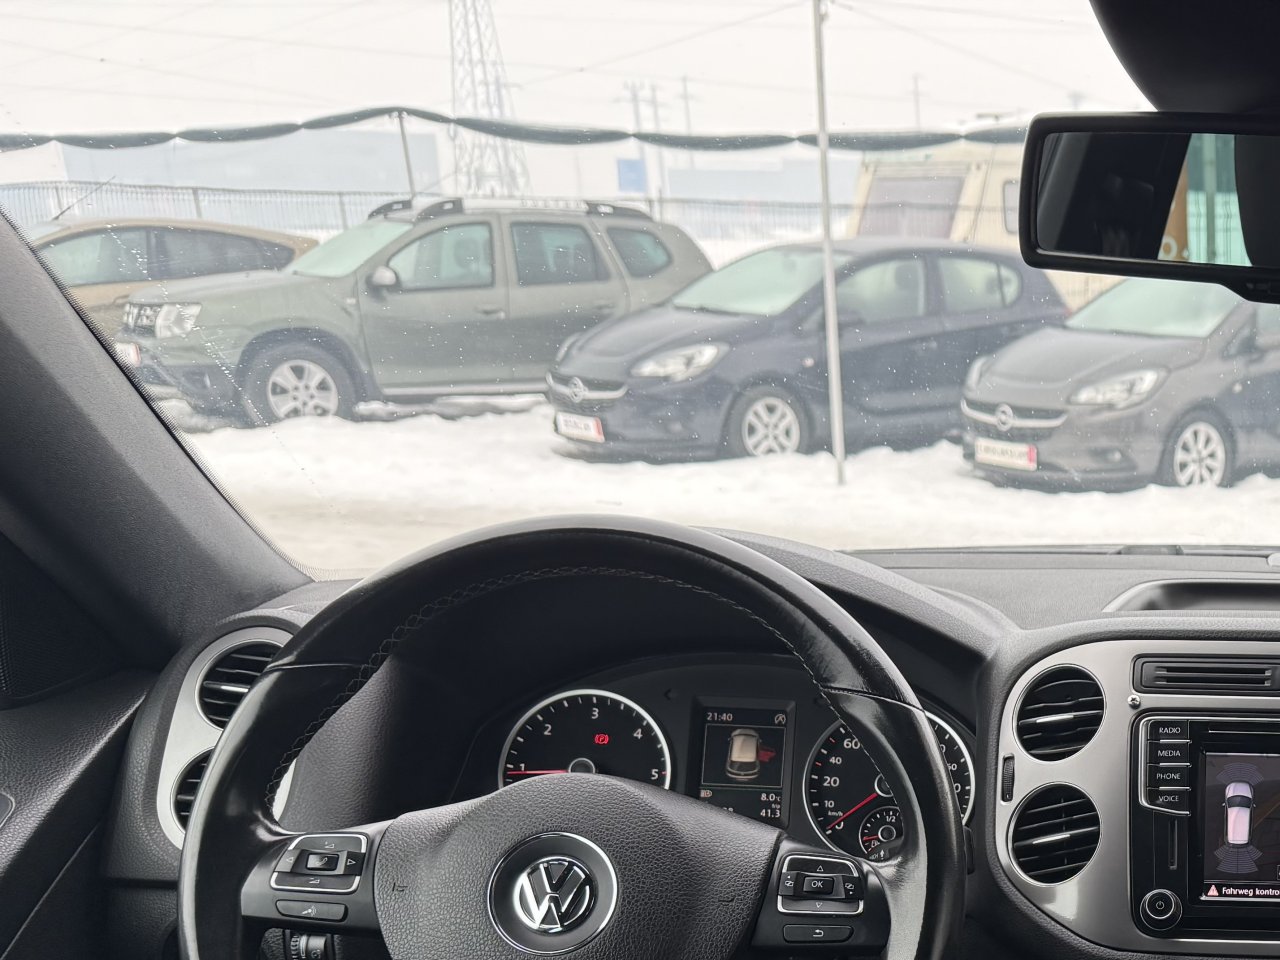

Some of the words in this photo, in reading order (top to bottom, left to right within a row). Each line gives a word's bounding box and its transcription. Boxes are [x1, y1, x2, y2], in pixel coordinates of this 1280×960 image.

[591, 707, 599, 719] 3
[706, 712, 733, 721] 21:40
[543, 724, 552, 735] 2
[633, 728, 643, 739] 4
[843, 738, 860, 749] 60
[829, 755, 842, 764] 40
[651, 769, 659, 780] 5
[823, 776, 839, 787] 20
[824, 800, 835, 808] 10
[760, 809, 781, 818] 41.3
[886, 815, 896, 823] 1/2
[811, 880, 824, 888] OK
[1222, 886, 1253, 897] Fahrweg
